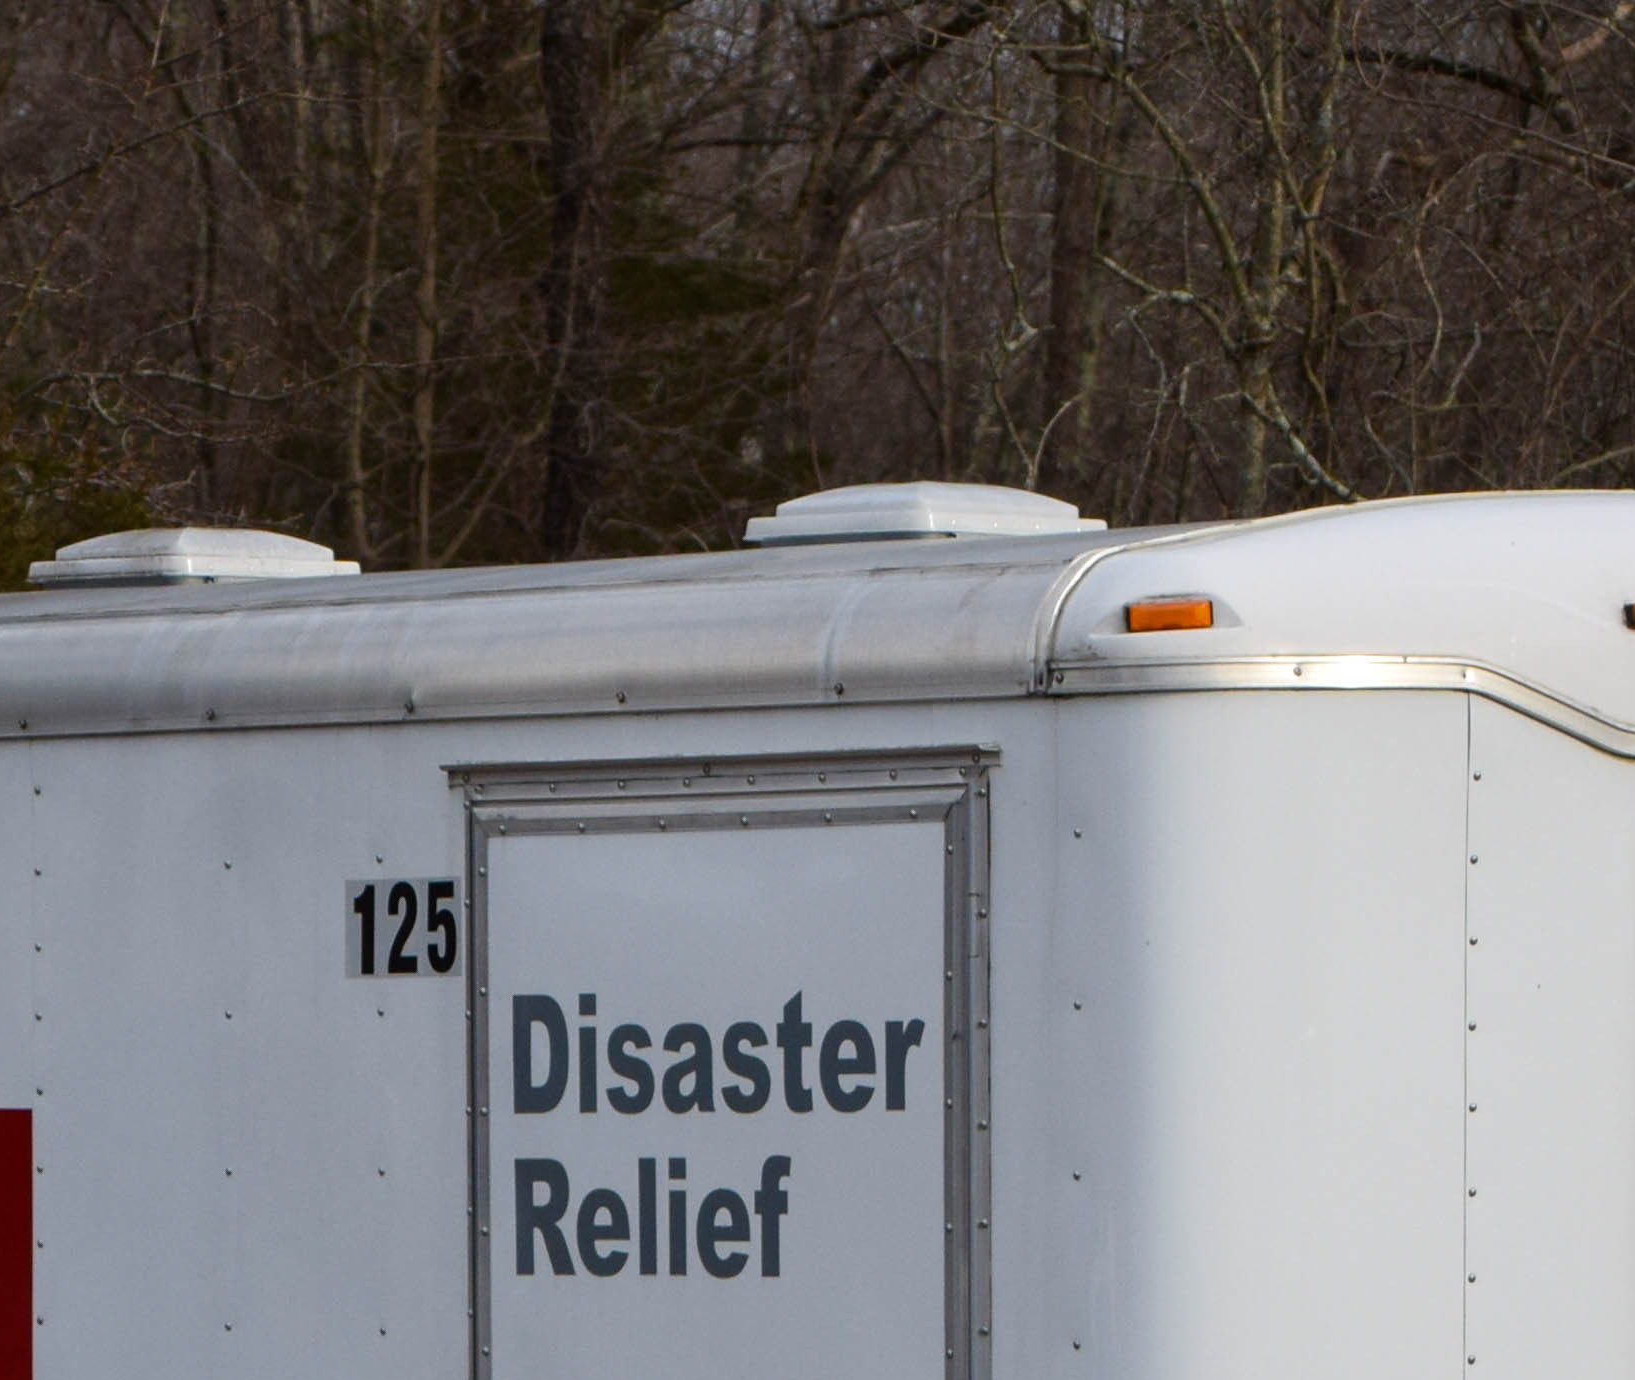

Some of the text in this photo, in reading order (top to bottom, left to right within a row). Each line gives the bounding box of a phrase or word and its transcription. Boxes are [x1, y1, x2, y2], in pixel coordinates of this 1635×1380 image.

[353, 880, 458, 976] 125
[512, 990, 925, 1115] Disaster
[514, 1155, 791, 1278] Relief
